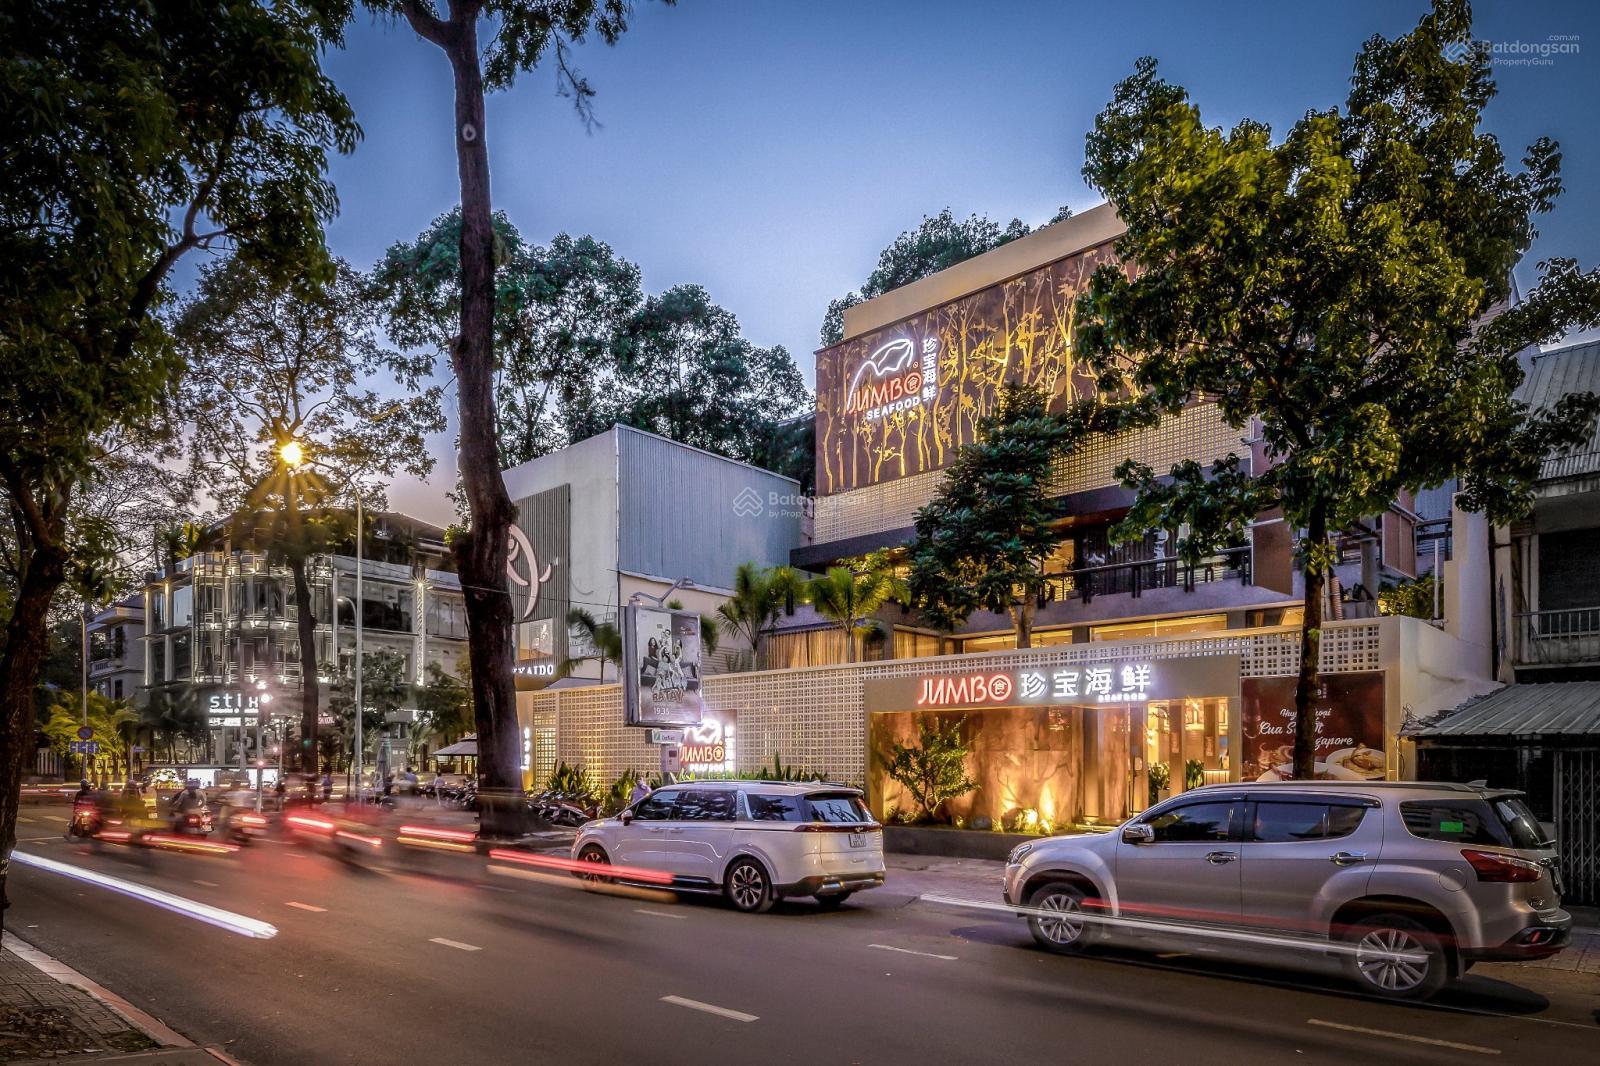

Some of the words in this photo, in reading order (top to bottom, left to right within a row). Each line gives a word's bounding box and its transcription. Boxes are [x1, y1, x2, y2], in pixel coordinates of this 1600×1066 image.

[848, 372, 922, 414] JUMBO
[865, 396, 921, 420] SEAFOOD
[917, 674, 1013, 704] JUMBO
[1019, 664, 1151, 698] 珍宝海鲜
[1259, 721, 1283, 735] Cua
[680, 745, 724, 762] JUMBO
